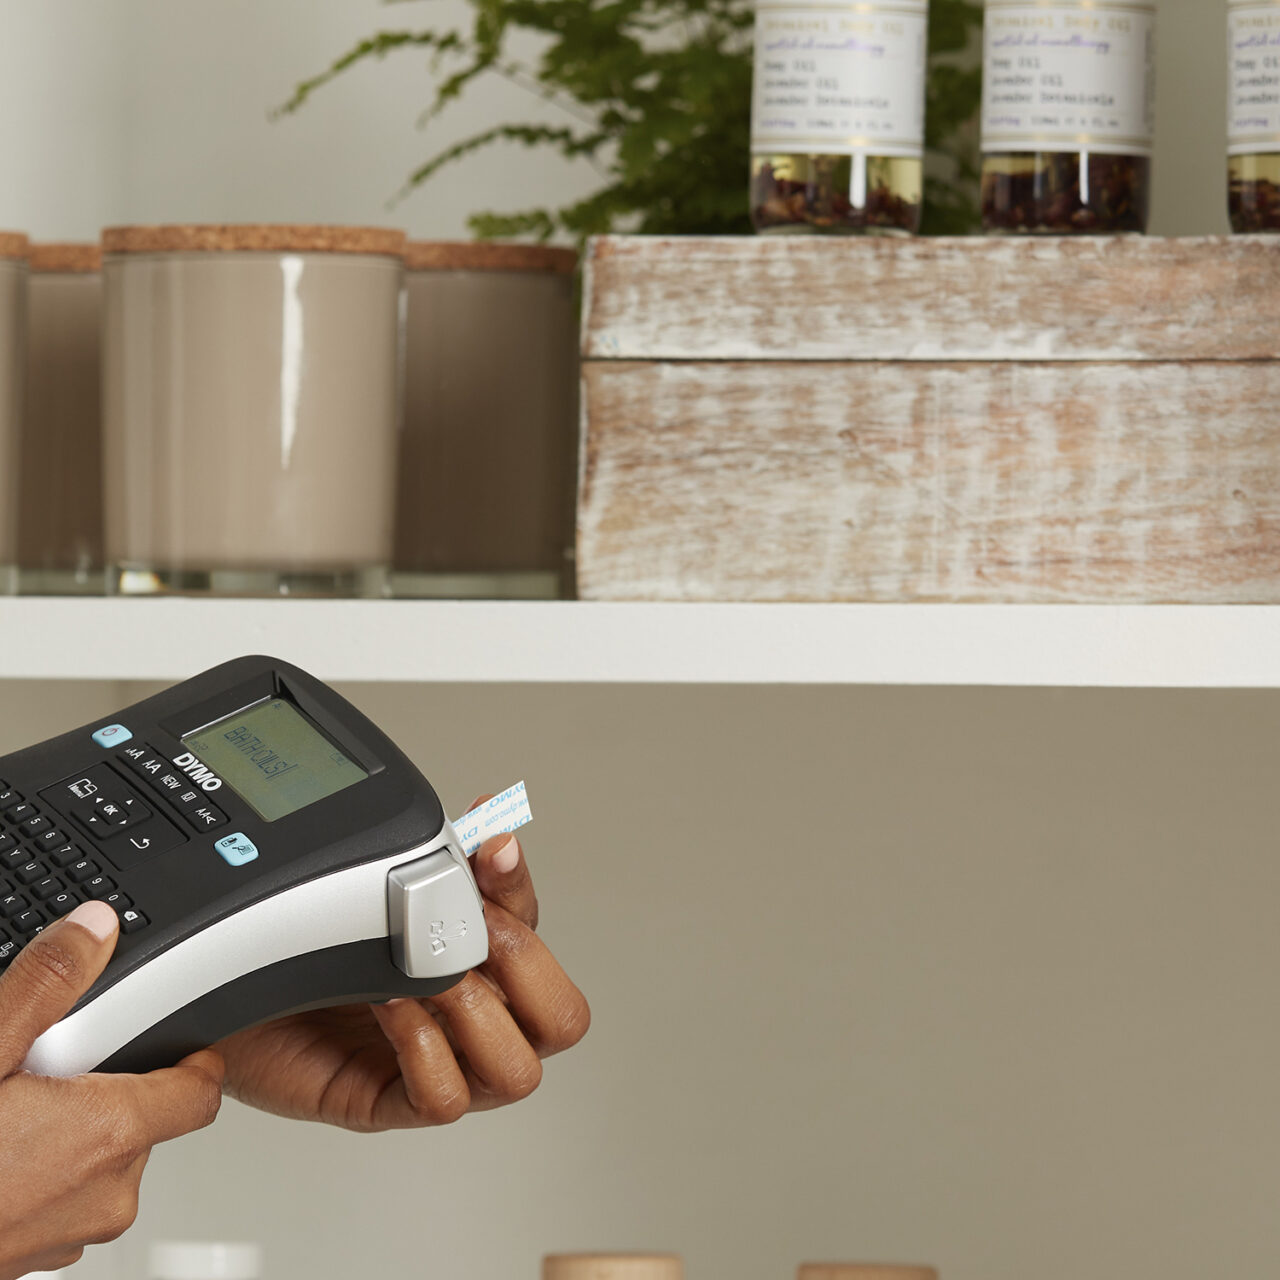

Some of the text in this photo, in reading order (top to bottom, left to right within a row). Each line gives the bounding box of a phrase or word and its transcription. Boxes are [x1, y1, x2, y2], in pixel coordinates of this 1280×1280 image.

[172, 752, 222, 791] DYMO
[160, 774, 181, 790] NEW
[103, 804, 119, 816] OK
